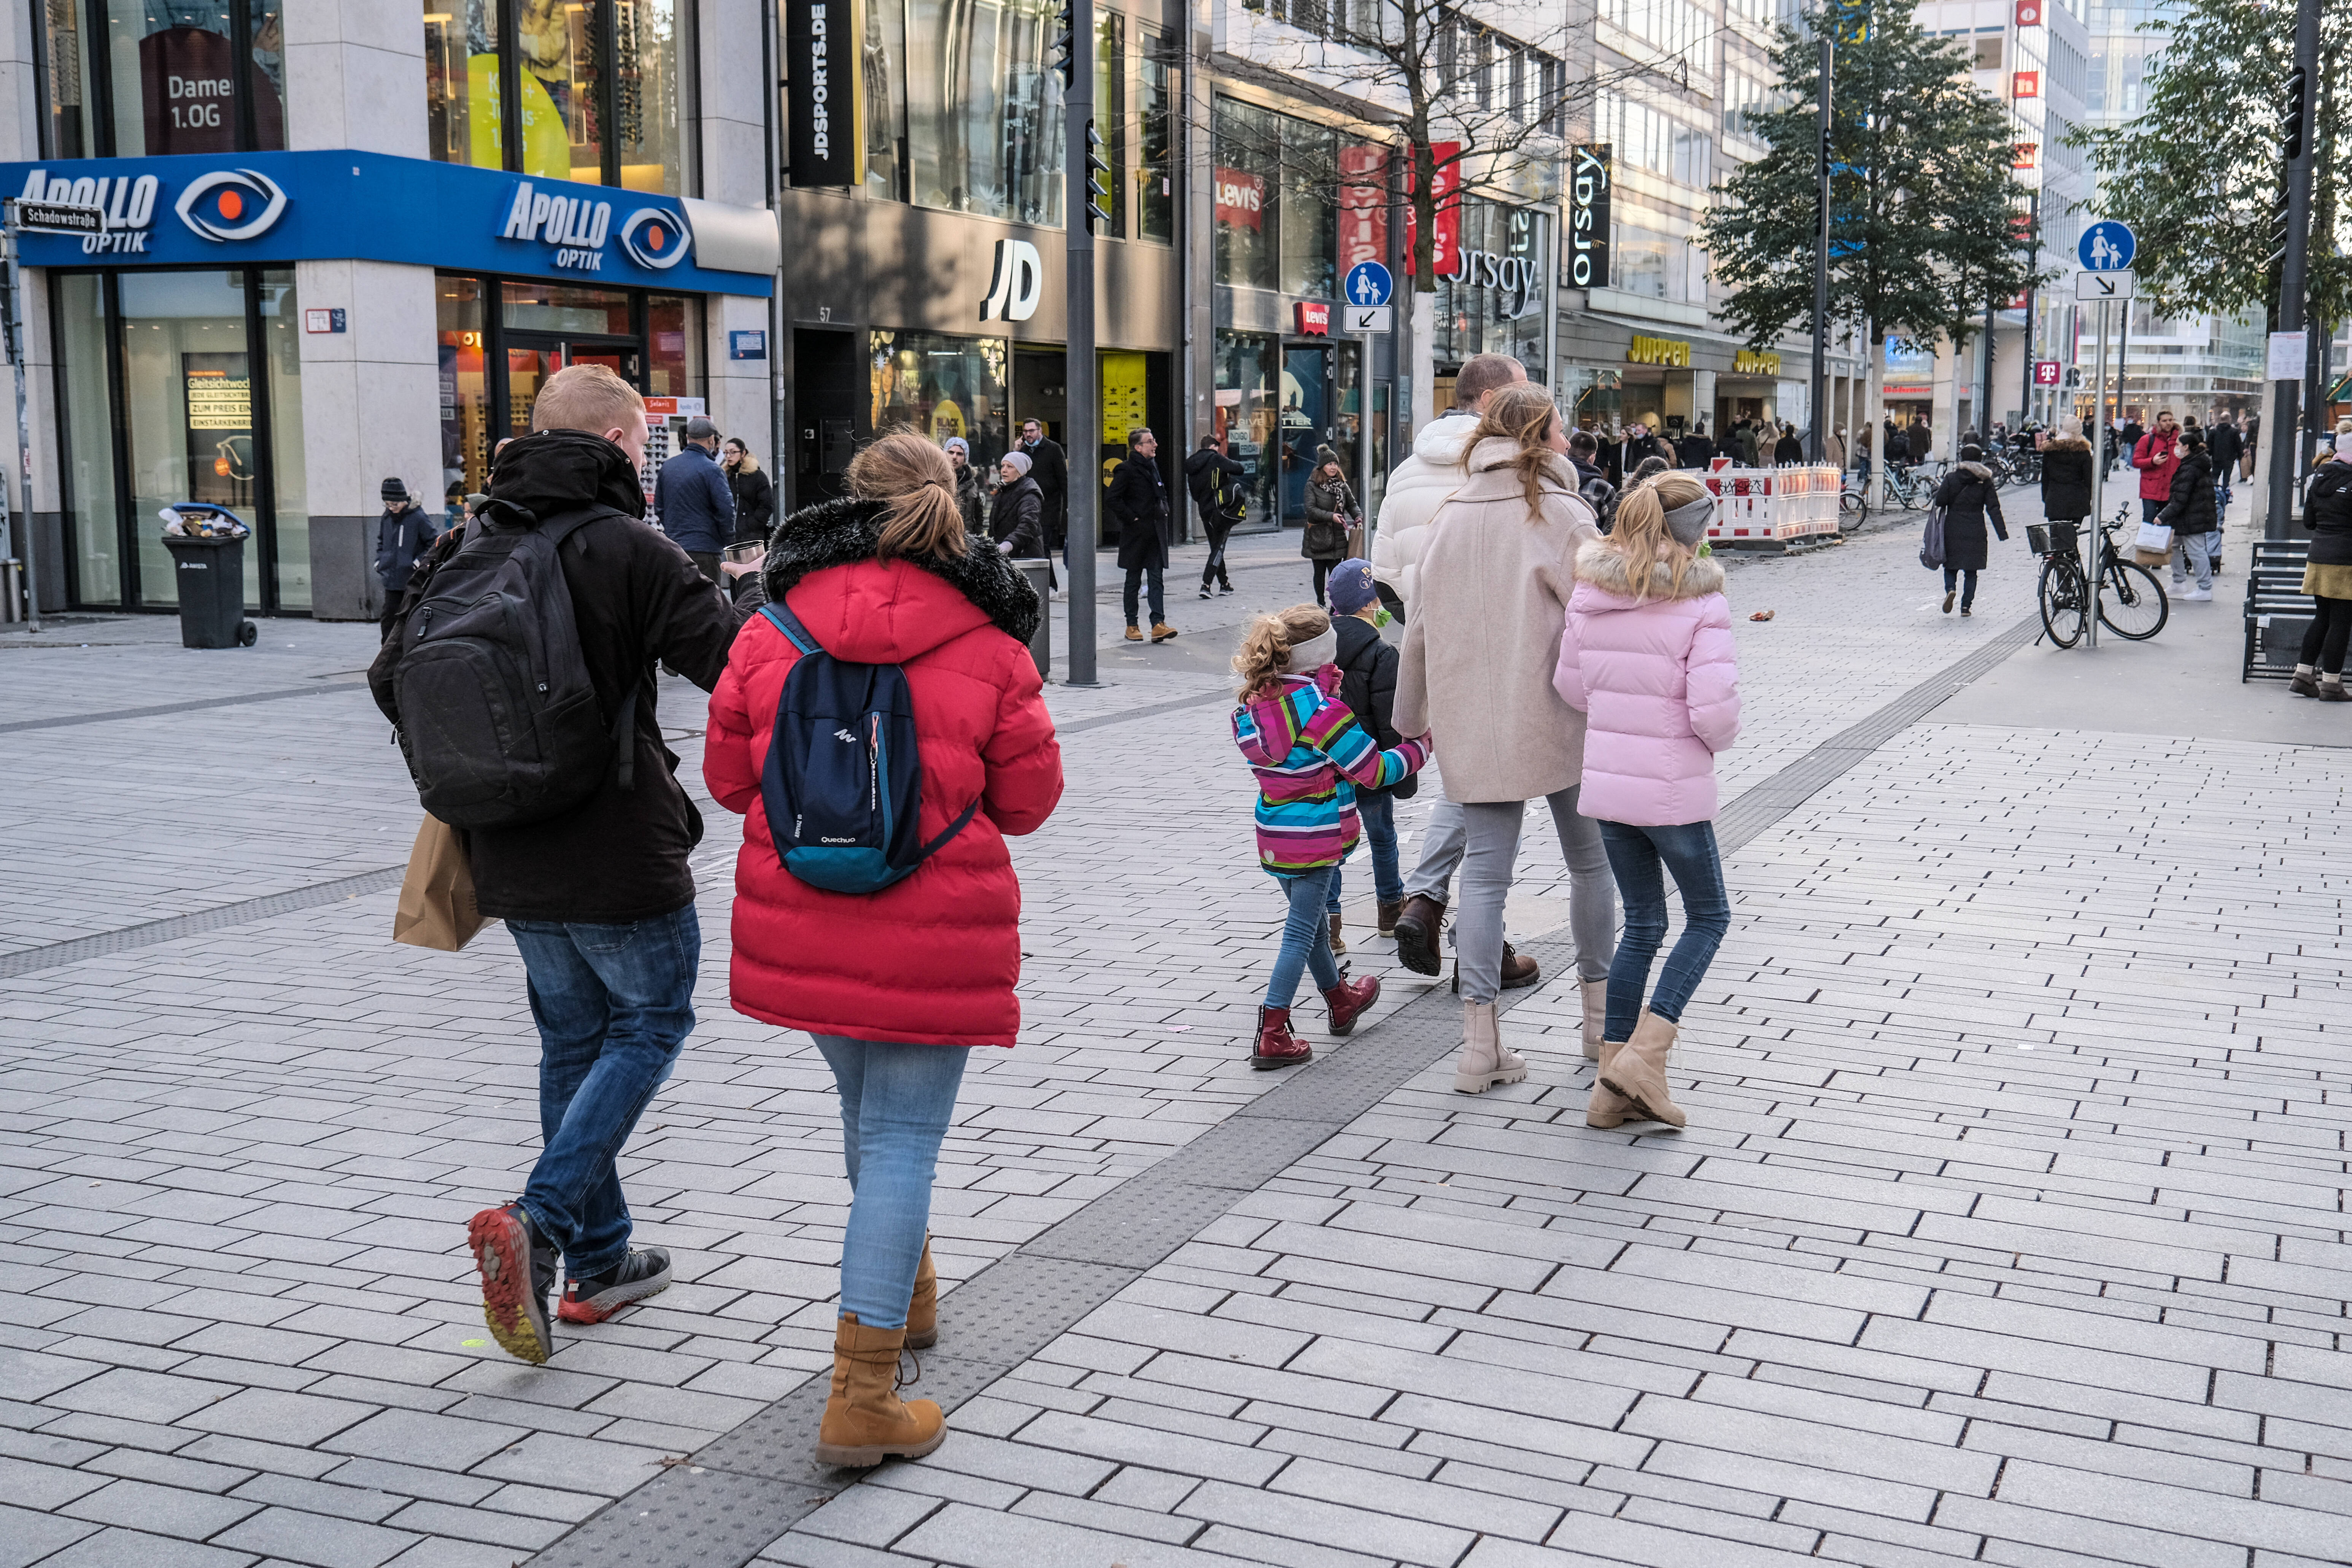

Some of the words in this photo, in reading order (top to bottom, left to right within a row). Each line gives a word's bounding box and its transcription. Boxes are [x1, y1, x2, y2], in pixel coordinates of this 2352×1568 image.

[811, 3, 829, 161] JDSPORTS.DE
[171, 103, 221, 128] 1.OG
[1216, 181, 1260, 212] Levi's
[27, 207, 97, 229] Schadowstraße
[504, 181, 612, 249] APOLLO
[1573, 146, 1607, 286] orsay
[82, 232, 149, 254] OPTIK
[557, 248, 604, 271] OPTIK
[987, 238, 1042, 321] JD
[820, 306, 831, 322] 57
[2041, 364, 2056, 381] T
[192, 404, 210, 413] ZUM
[213, 404, 236, 413] PREIS
[1230, 432, 1248, 440] INDIGO
[1244, 462, 1255, 471] OFF
